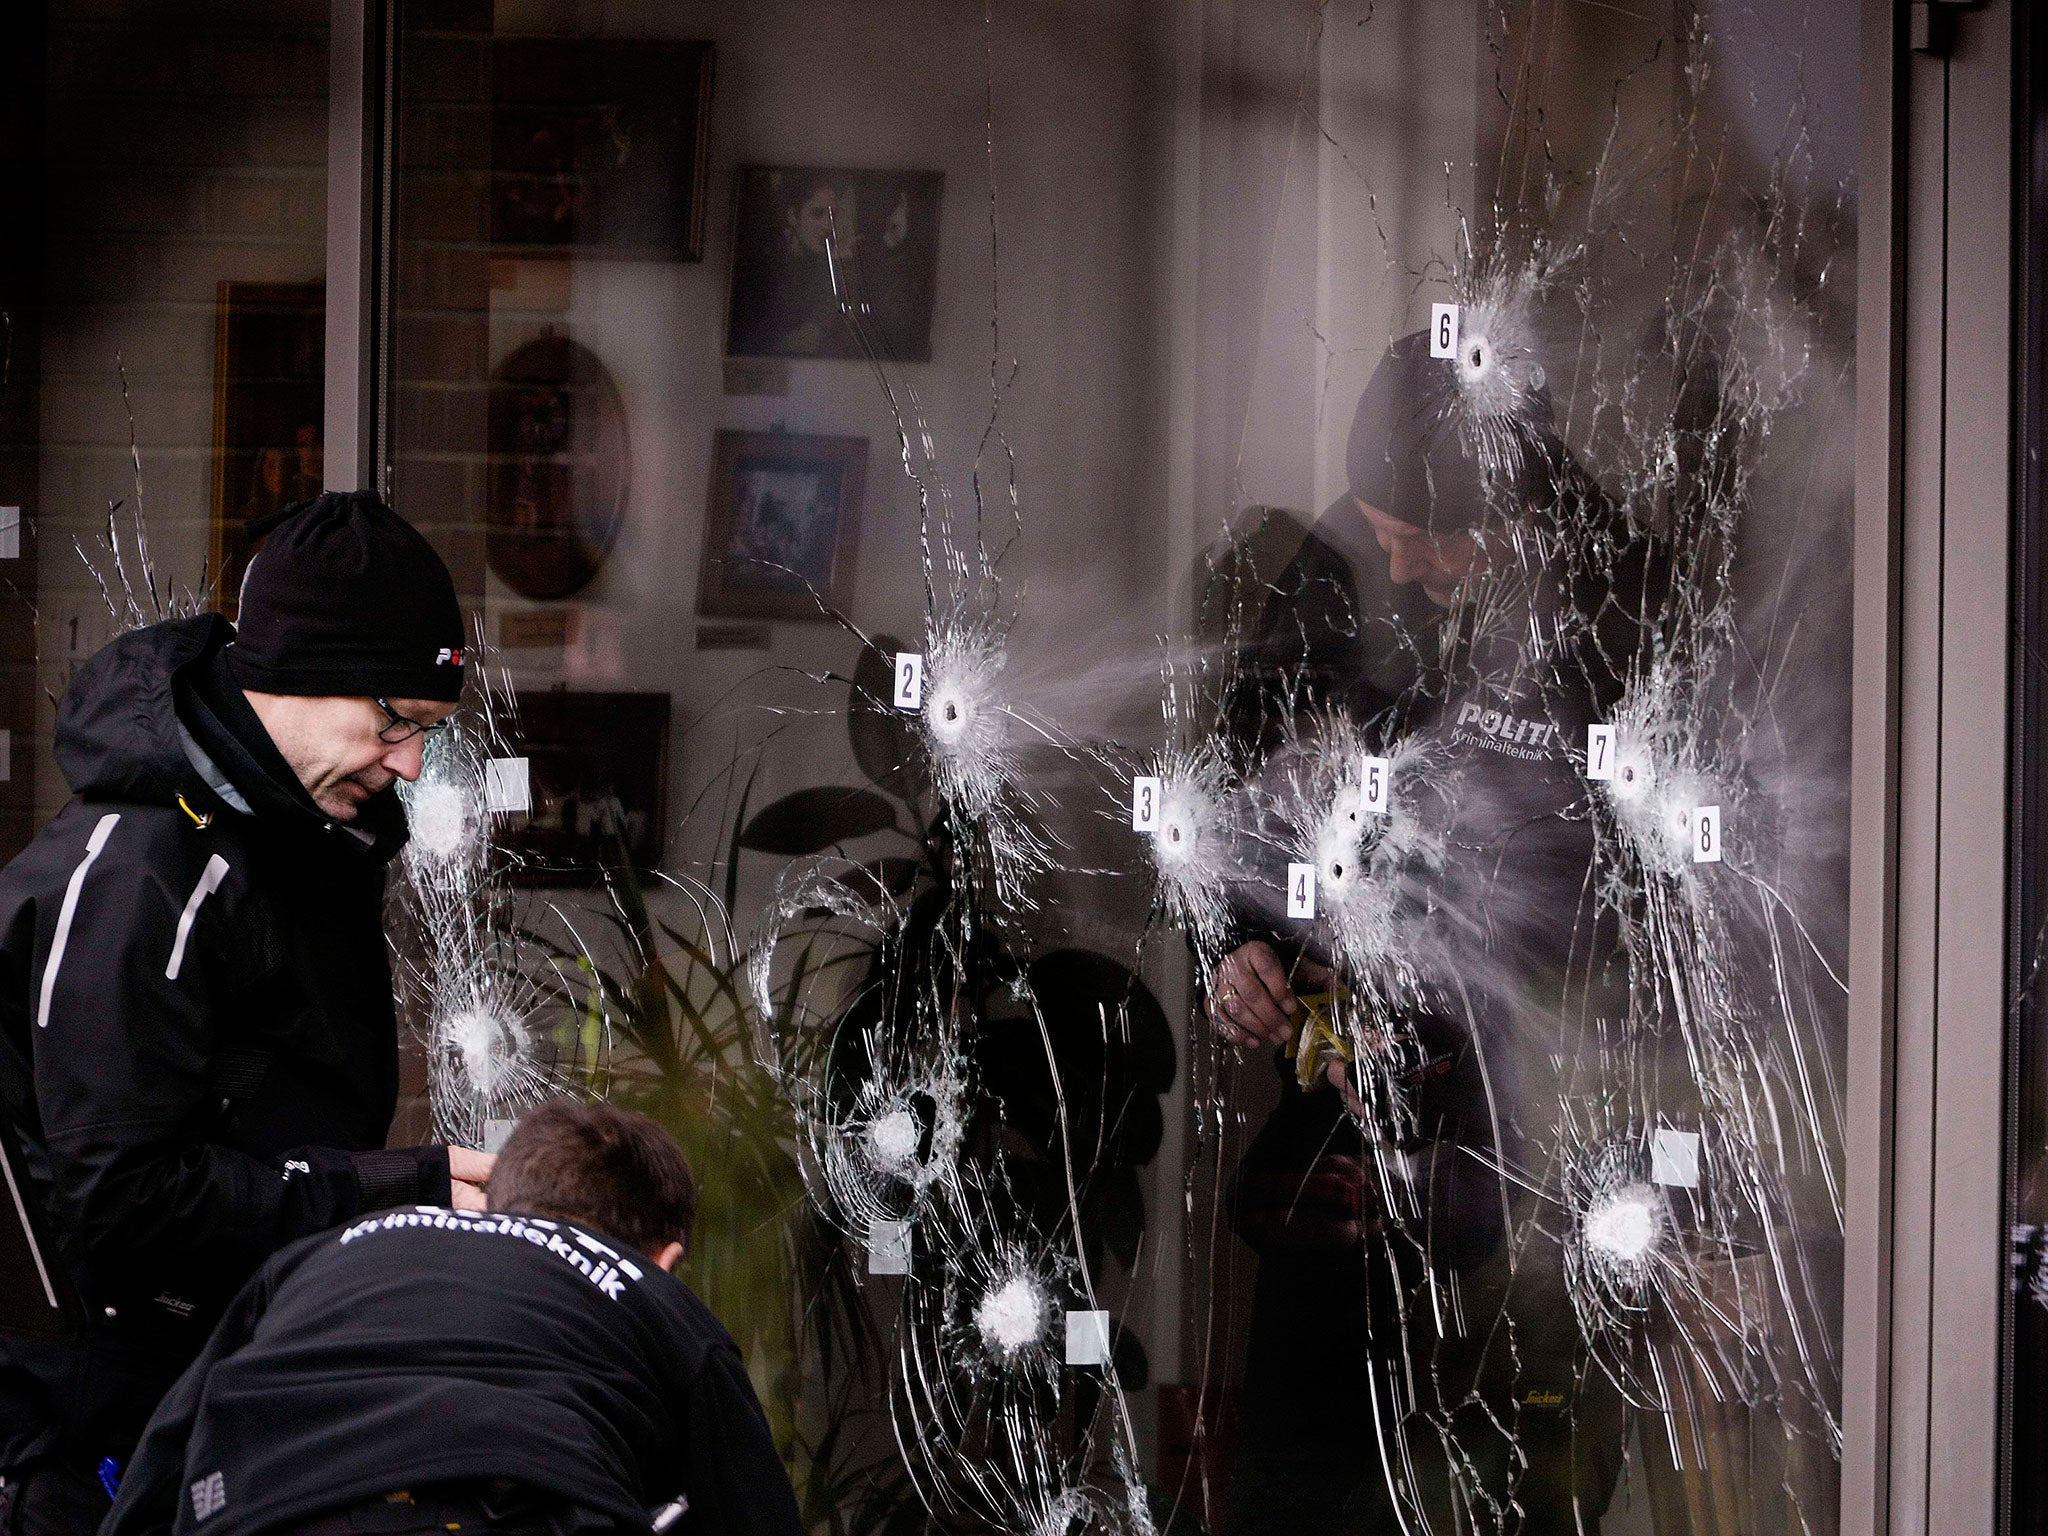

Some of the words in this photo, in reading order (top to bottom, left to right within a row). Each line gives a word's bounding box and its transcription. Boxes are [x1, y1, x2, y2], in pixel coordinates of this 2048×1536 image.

[1439, 313, 1452, 350] 6
[901, 663, 913, 699] 2
[1595, 734, 1608, 770] 7
[1368, 766, 1381, 803] 5
[1140, 786, 1152, 822] 3
[1700, 816, 1712, 853] 8
[1295, 873, 1307, 909] 4
